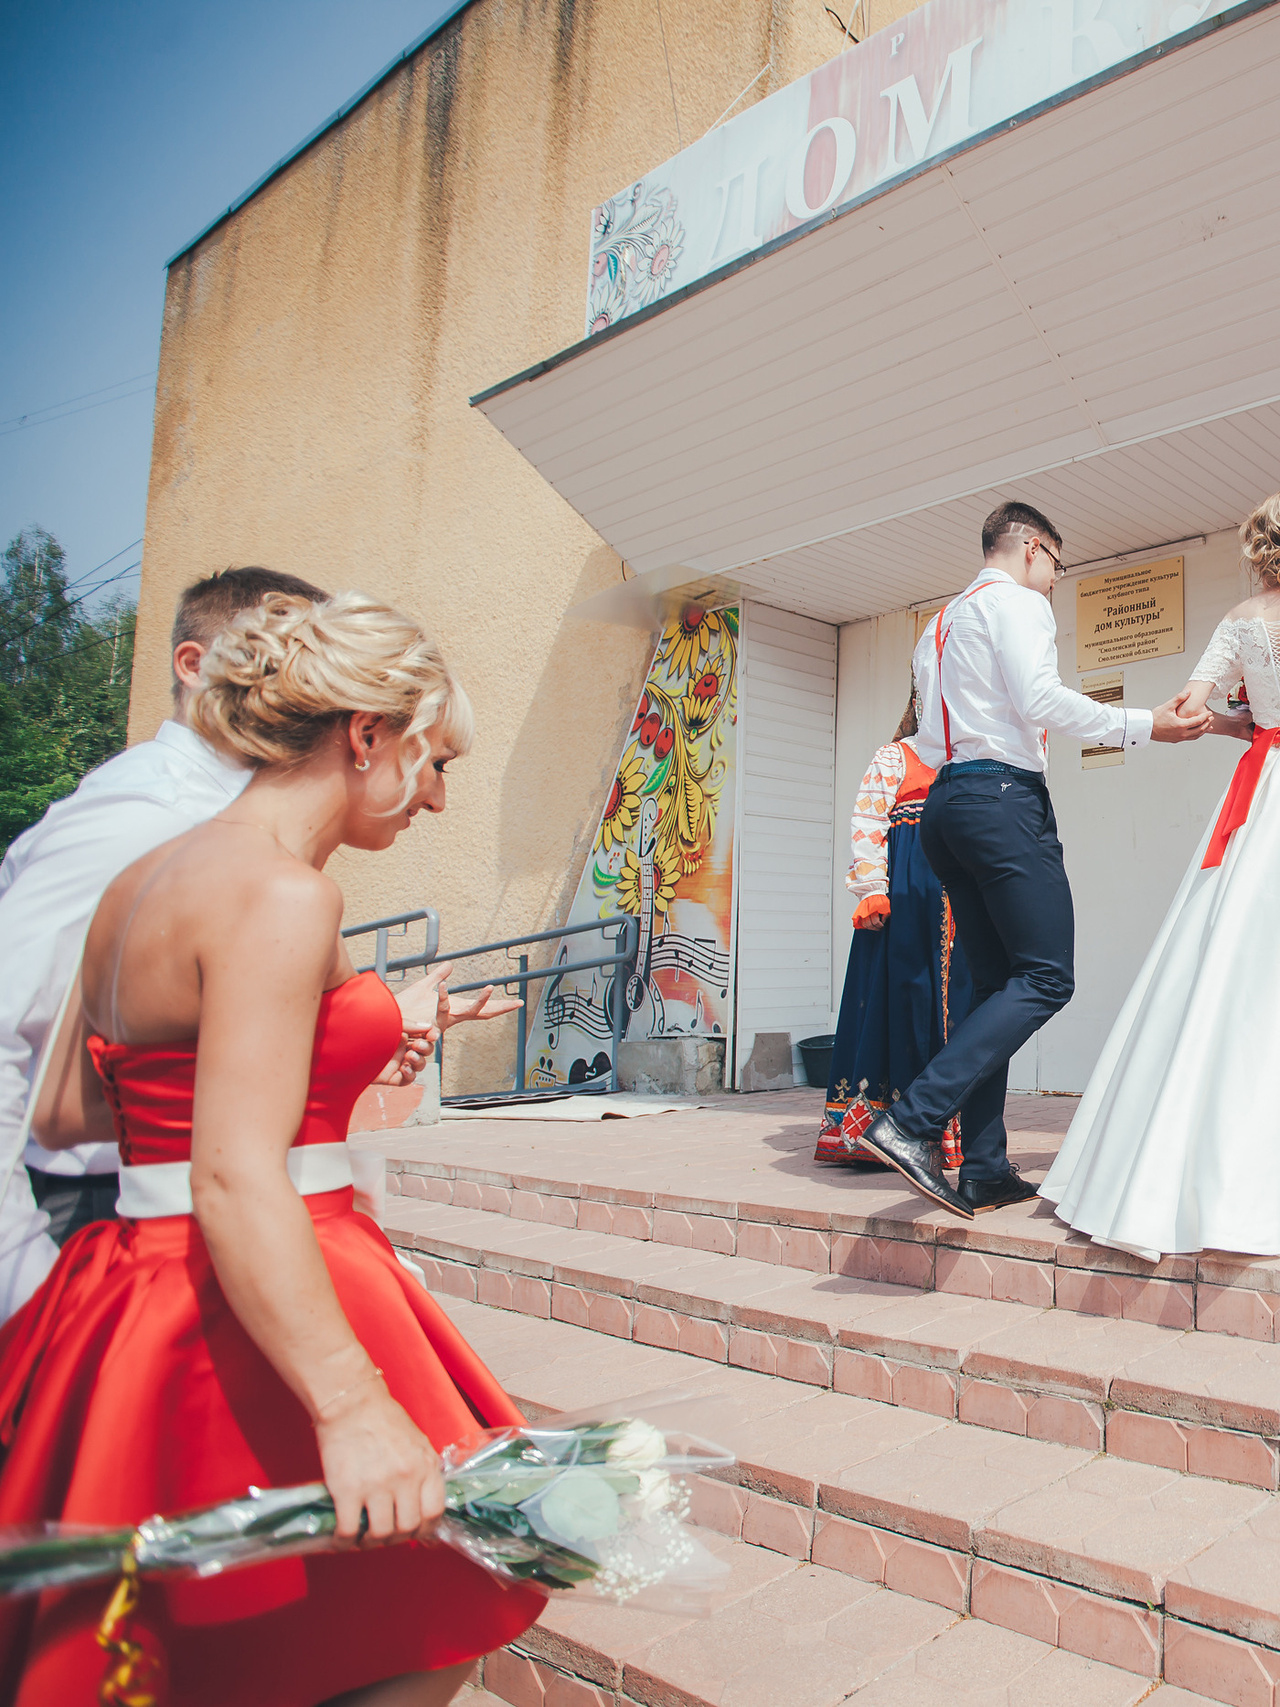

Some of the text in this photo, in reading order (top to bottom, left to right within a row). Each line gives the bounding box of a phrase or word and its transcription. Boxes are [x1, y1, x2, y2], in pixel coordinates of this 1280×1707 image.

[703, 36, 984, 275] ДОМ
[1104, 569, 1152, 584] Муниципальное
[1080, 571, 1179, 598] бюджетное учреждение культуры
[1107, 586, 1150, 601] клубного типа
[1094, 620, 1113, 634] дом
[1084, 627, 1173, 649] муниципального образования
[1098, 647, 1159, 662] Смоленской области
